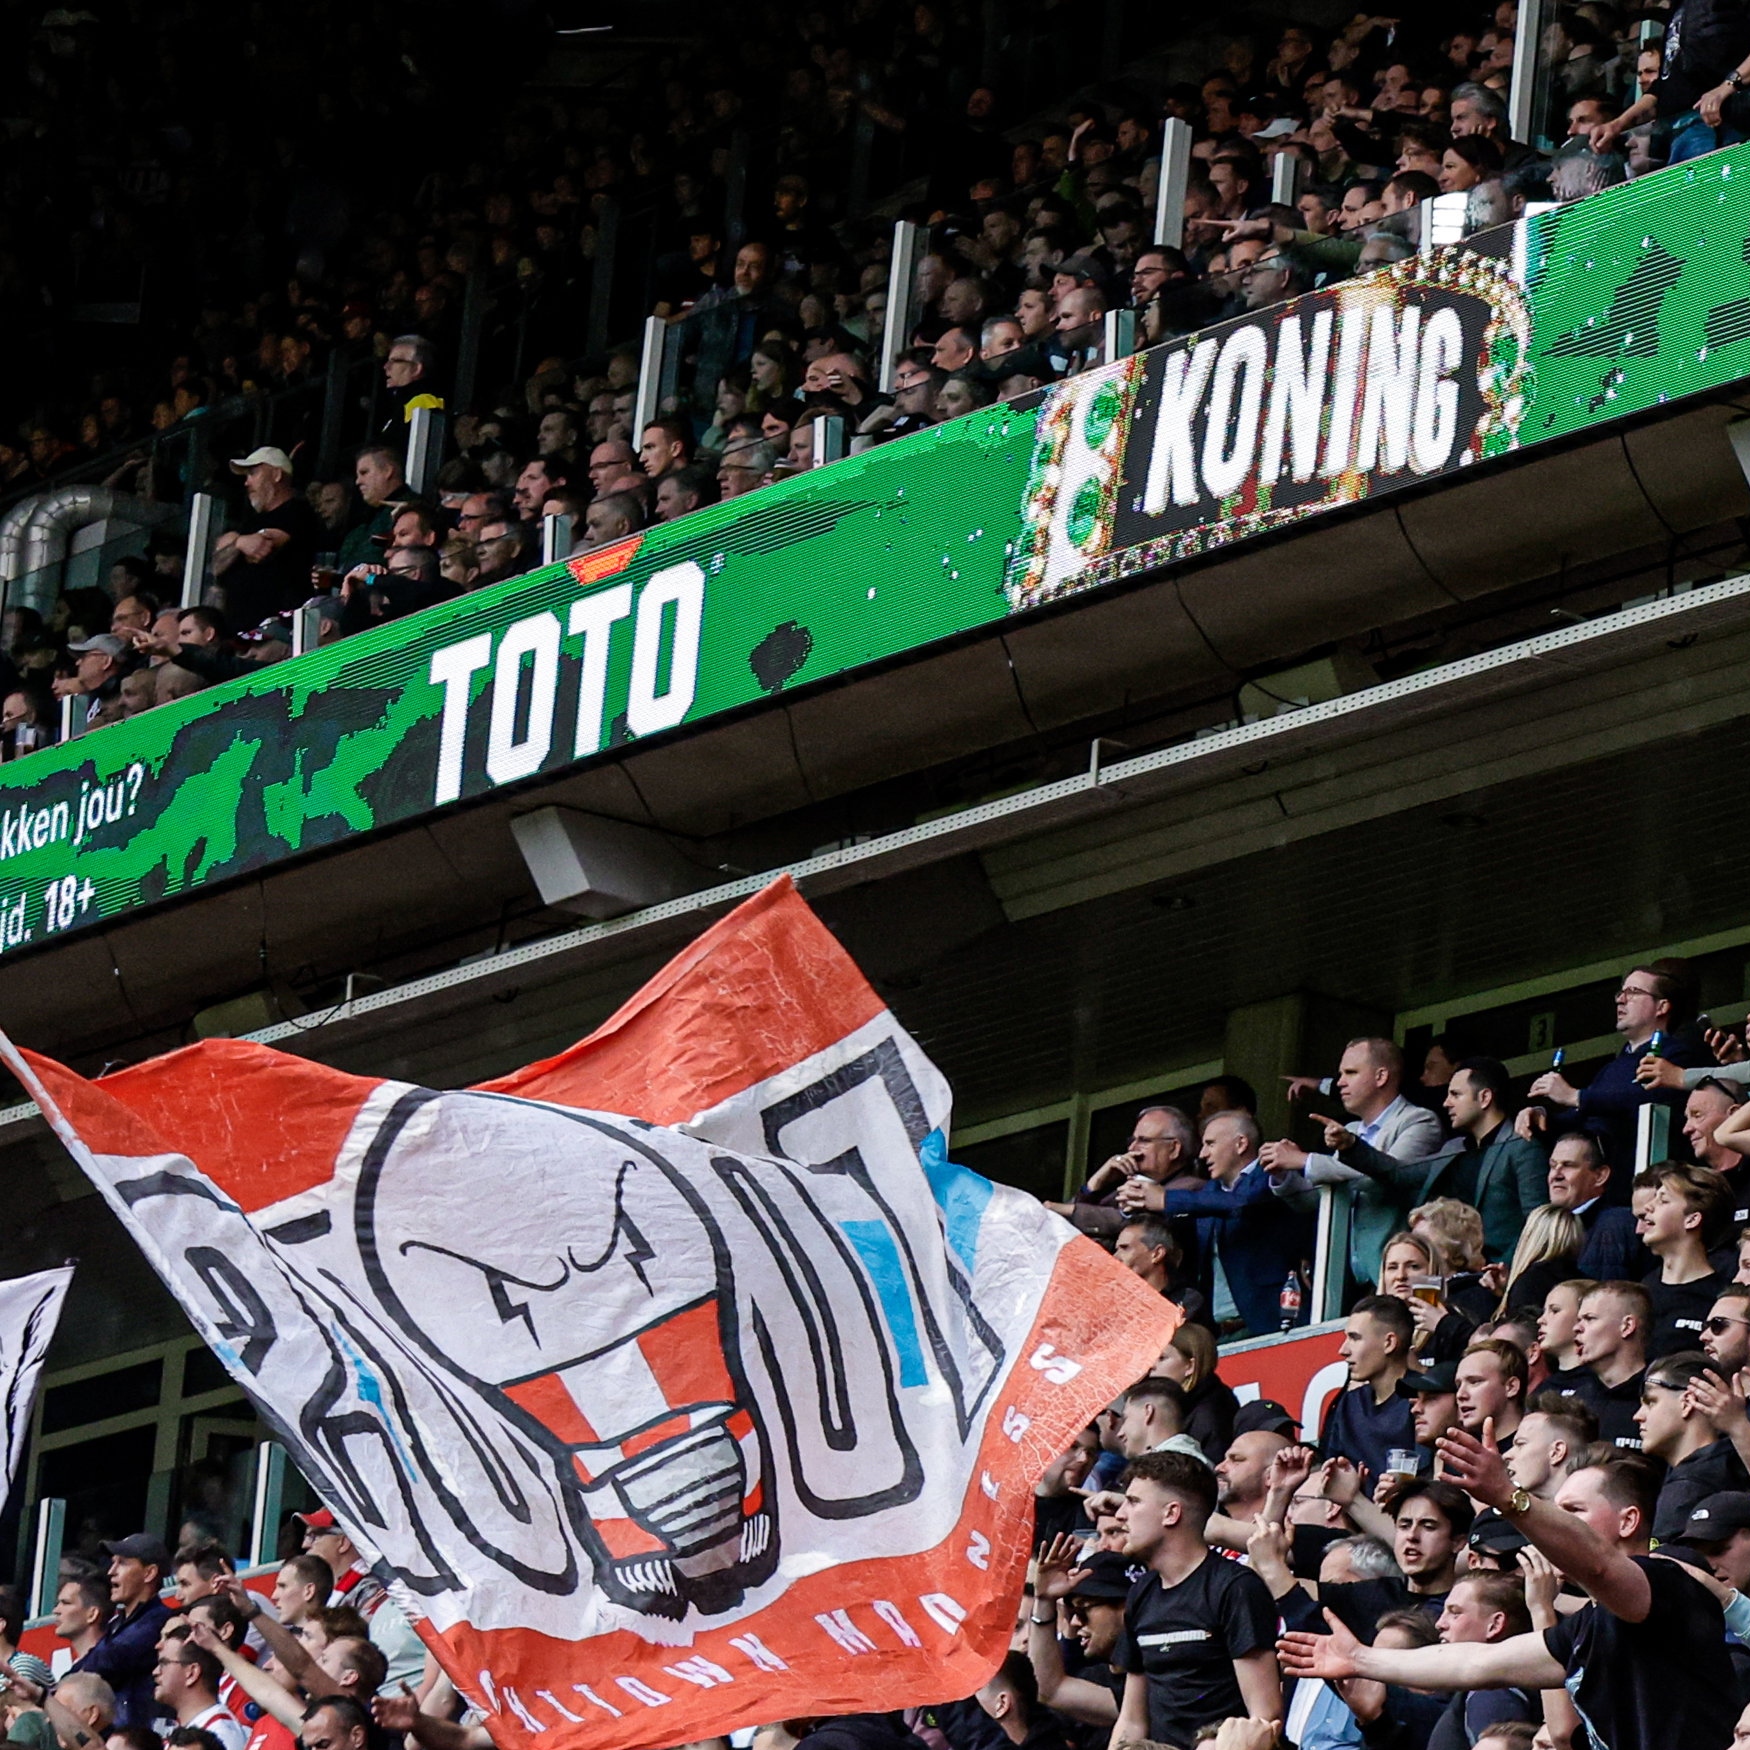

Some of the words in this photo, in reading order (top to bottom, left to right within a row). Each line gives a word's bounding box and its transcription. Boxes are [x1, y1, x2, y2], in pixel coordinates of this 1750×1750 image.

[1142, 302, 1463, 515] KONING
[429, 558, 707, 806] TOTO
[0, 801, 69, 861] kken
[73, 762, 145, 845] jou?
[0, 891, 33, 955] id.
[44, 874, 96, 933] 18+
